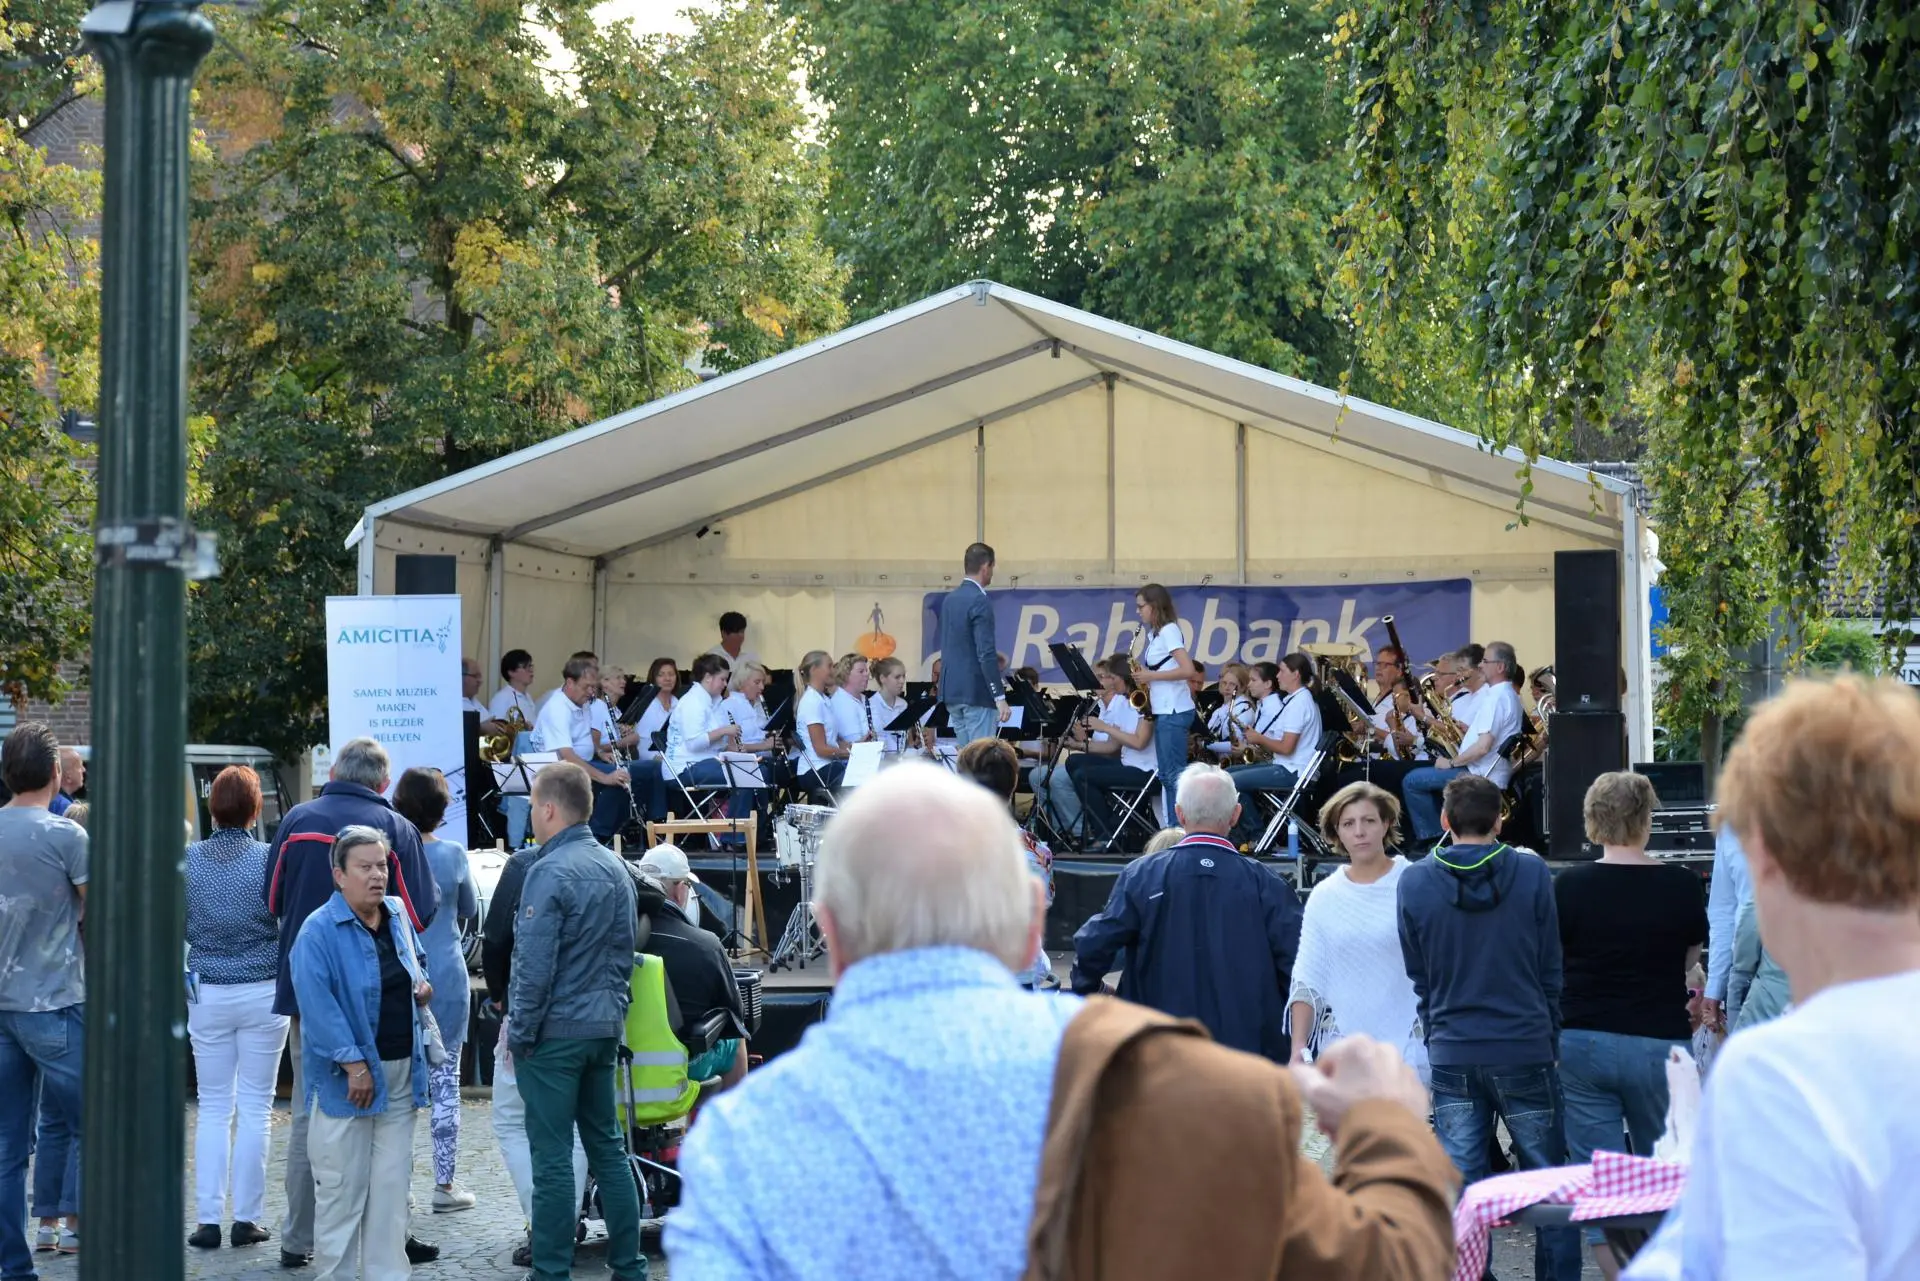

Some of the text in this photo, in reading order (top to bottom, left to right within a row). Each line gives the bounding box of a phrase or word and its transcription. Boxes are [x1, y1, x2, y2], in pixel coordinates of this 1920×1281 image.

[337, 628, 435, 644] AMICITIA
[353, 687, 438, 698] SAMEN MUZIEK
[376, 703, 416, 712] MAKEN
[369, 718, 424, 728] IS PLEZIER
[374, 733, 421, 742] BELEVEN
